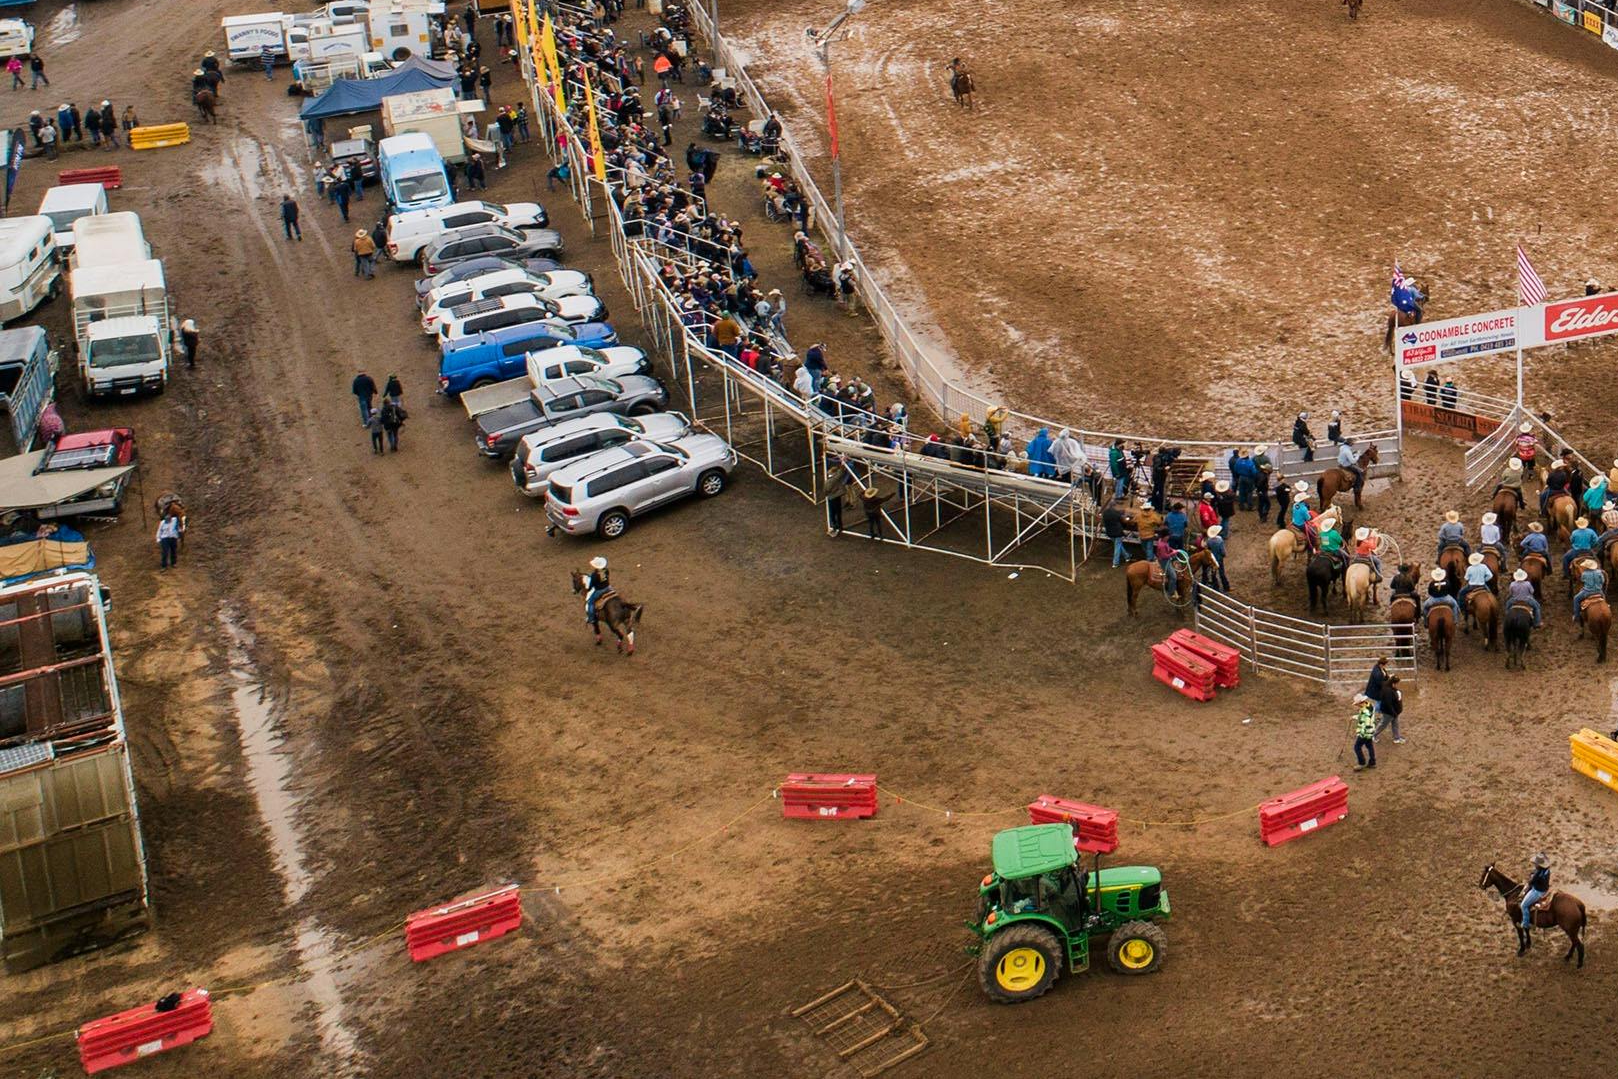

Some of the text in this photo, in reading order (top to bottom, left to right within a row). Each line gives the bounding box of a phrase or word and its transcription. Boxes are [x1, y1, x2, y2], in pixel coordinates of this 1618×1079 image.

[1419, 316, 1515, 343] COONAMBLE CONCRETE
[1437, 410, 1475, 429] SECURITY
